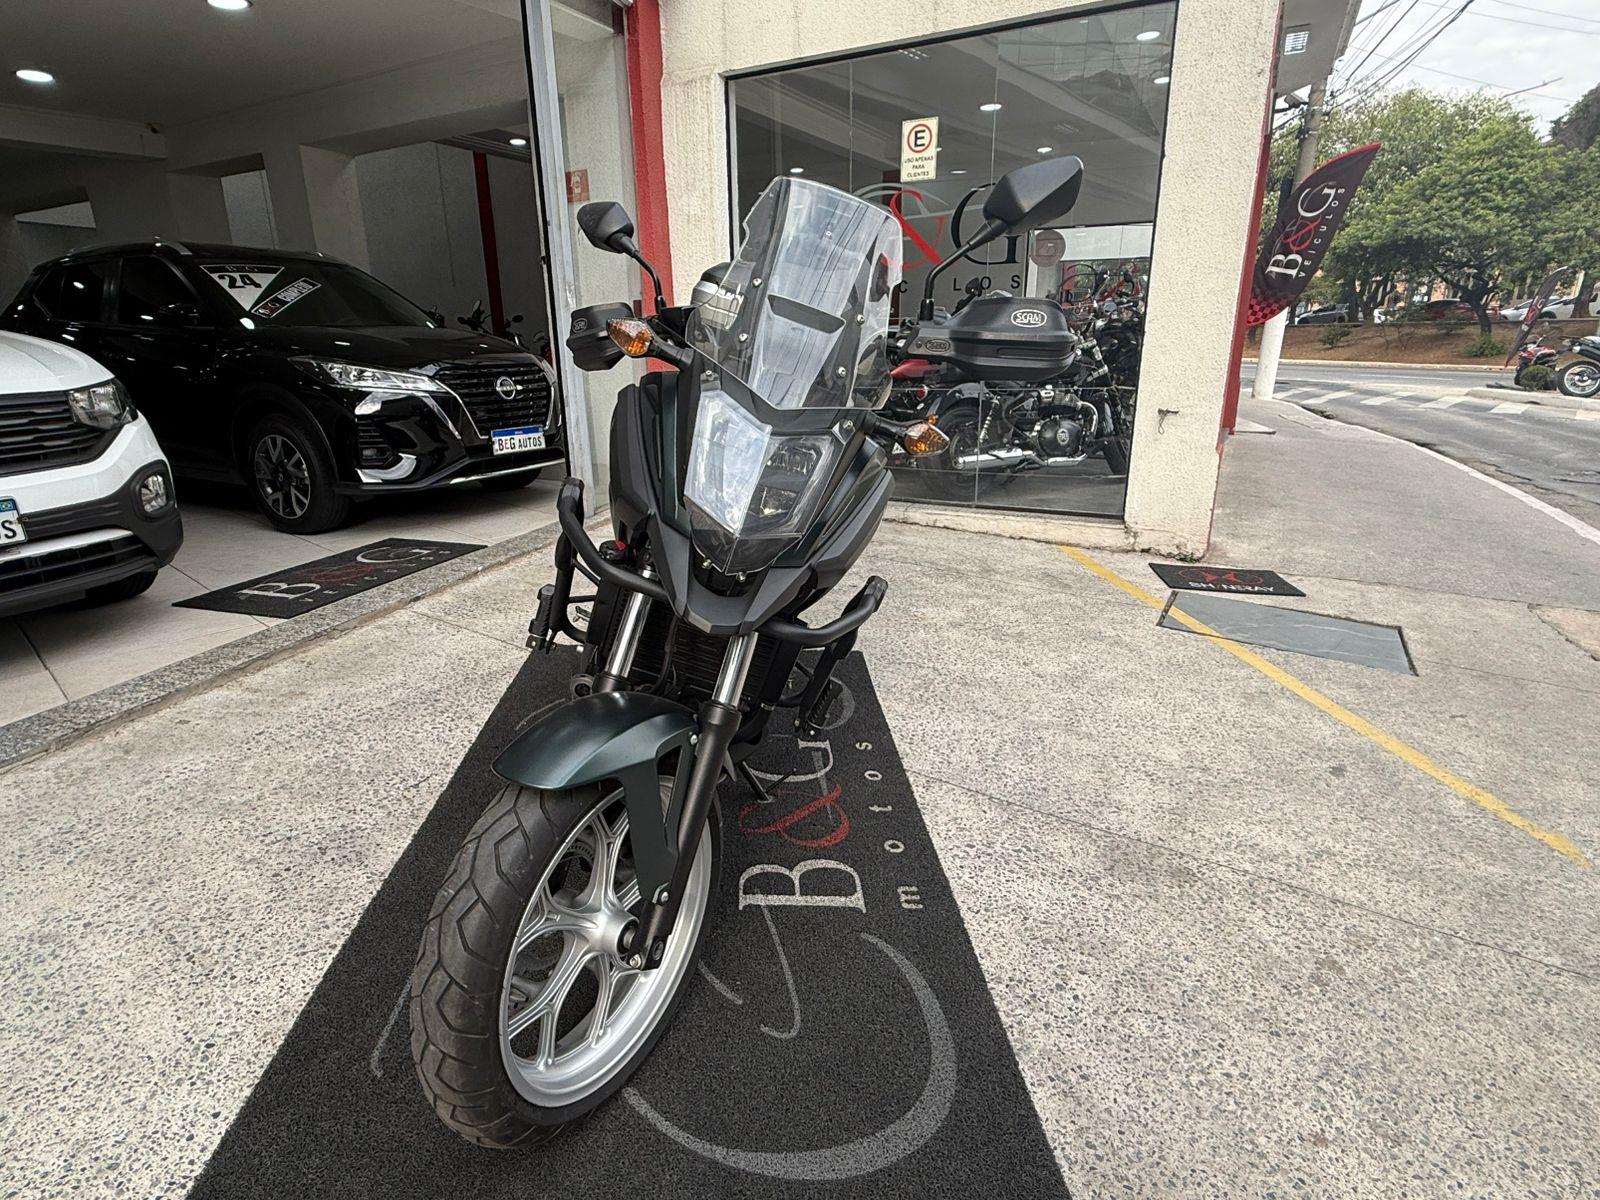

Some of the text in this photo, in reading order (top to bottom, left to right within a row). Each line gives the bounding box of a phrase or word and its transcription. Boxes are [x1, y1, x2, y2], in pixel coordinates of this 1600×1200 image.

[914, 129, 926, 148] E
[217, 274, 262, 289] 24
[518, 436, 542, 449] AUTOS
